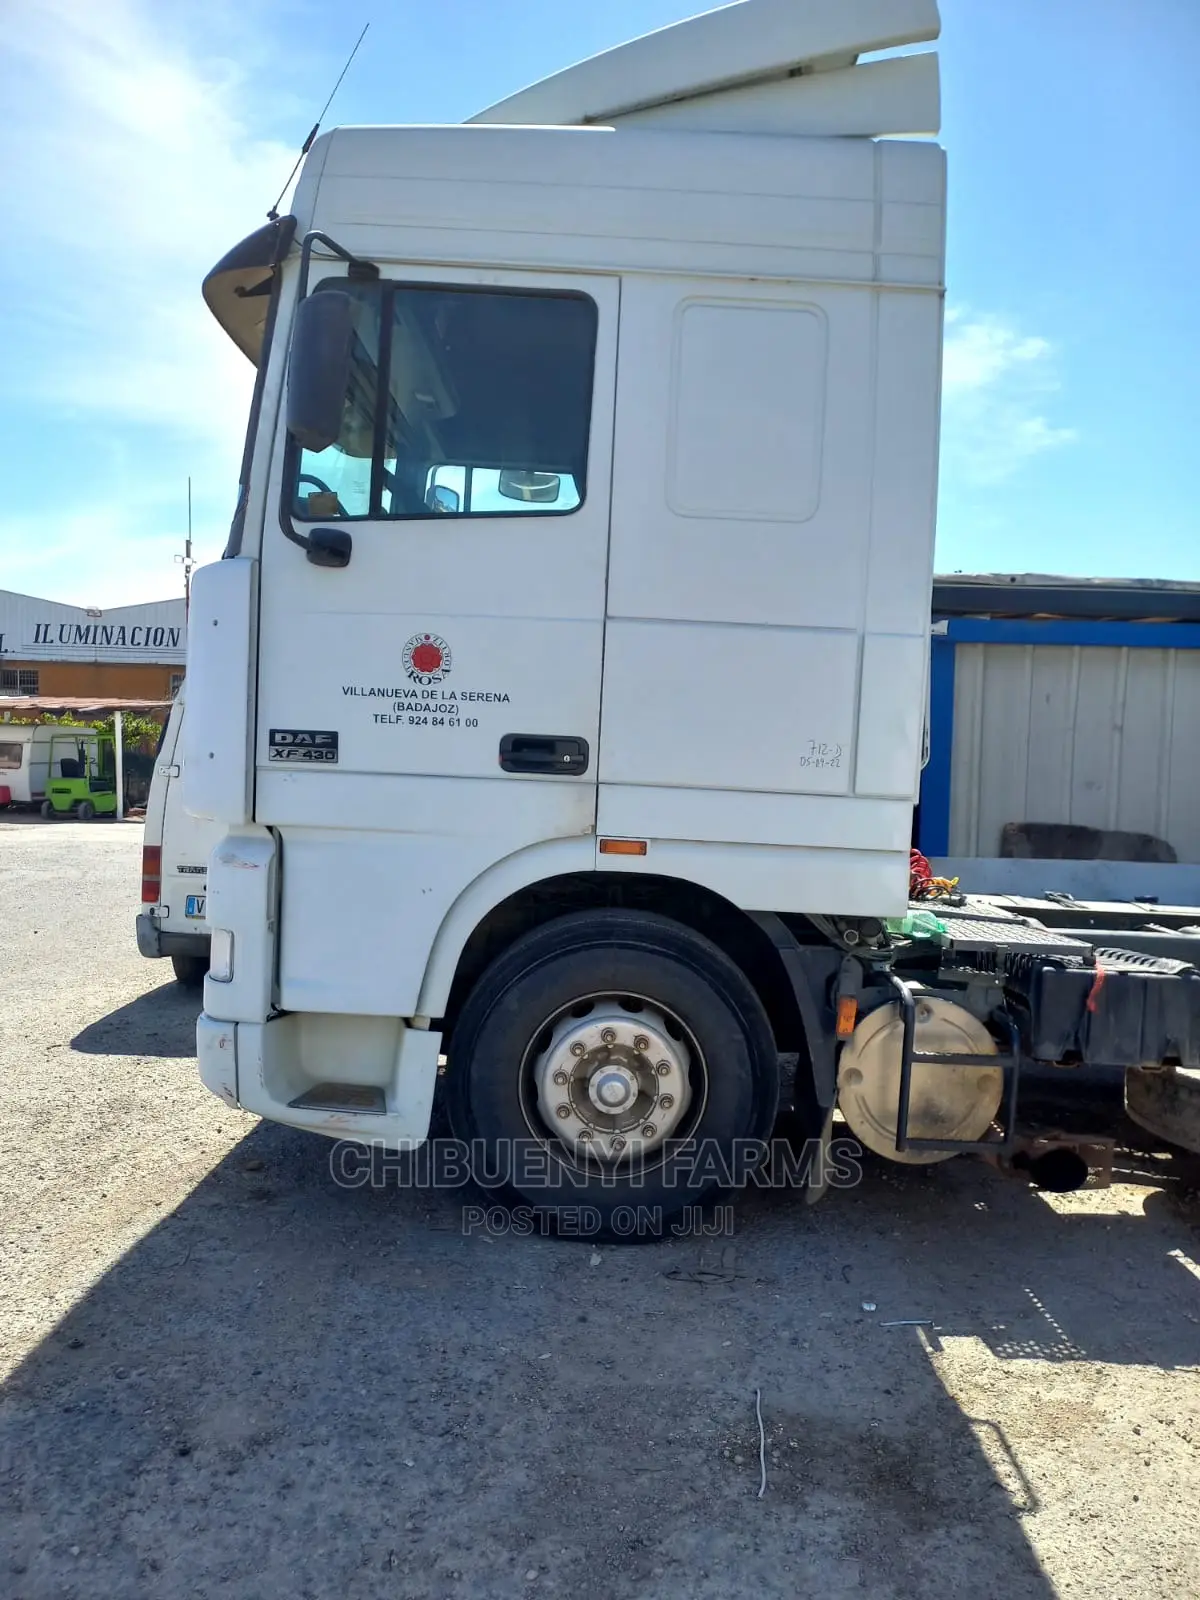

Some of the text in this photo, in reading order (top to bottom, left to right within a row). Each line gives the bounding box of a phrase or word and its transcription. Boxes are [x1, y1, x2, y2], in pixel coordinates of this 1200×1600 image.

[33, 623, 182, 648] ILUMINACION
[408, 669, 452, 686] ROSA
[342, 686, 510, 703] VILLANUEVA DE LA SERENA
[393, 701, 459, 715] (BADAJOZ)
[373, 713, 479, 728] TELF. 924 84 61 00
[274, 732, 332, 744] DAF
[302, 750, 336, 760] 430
